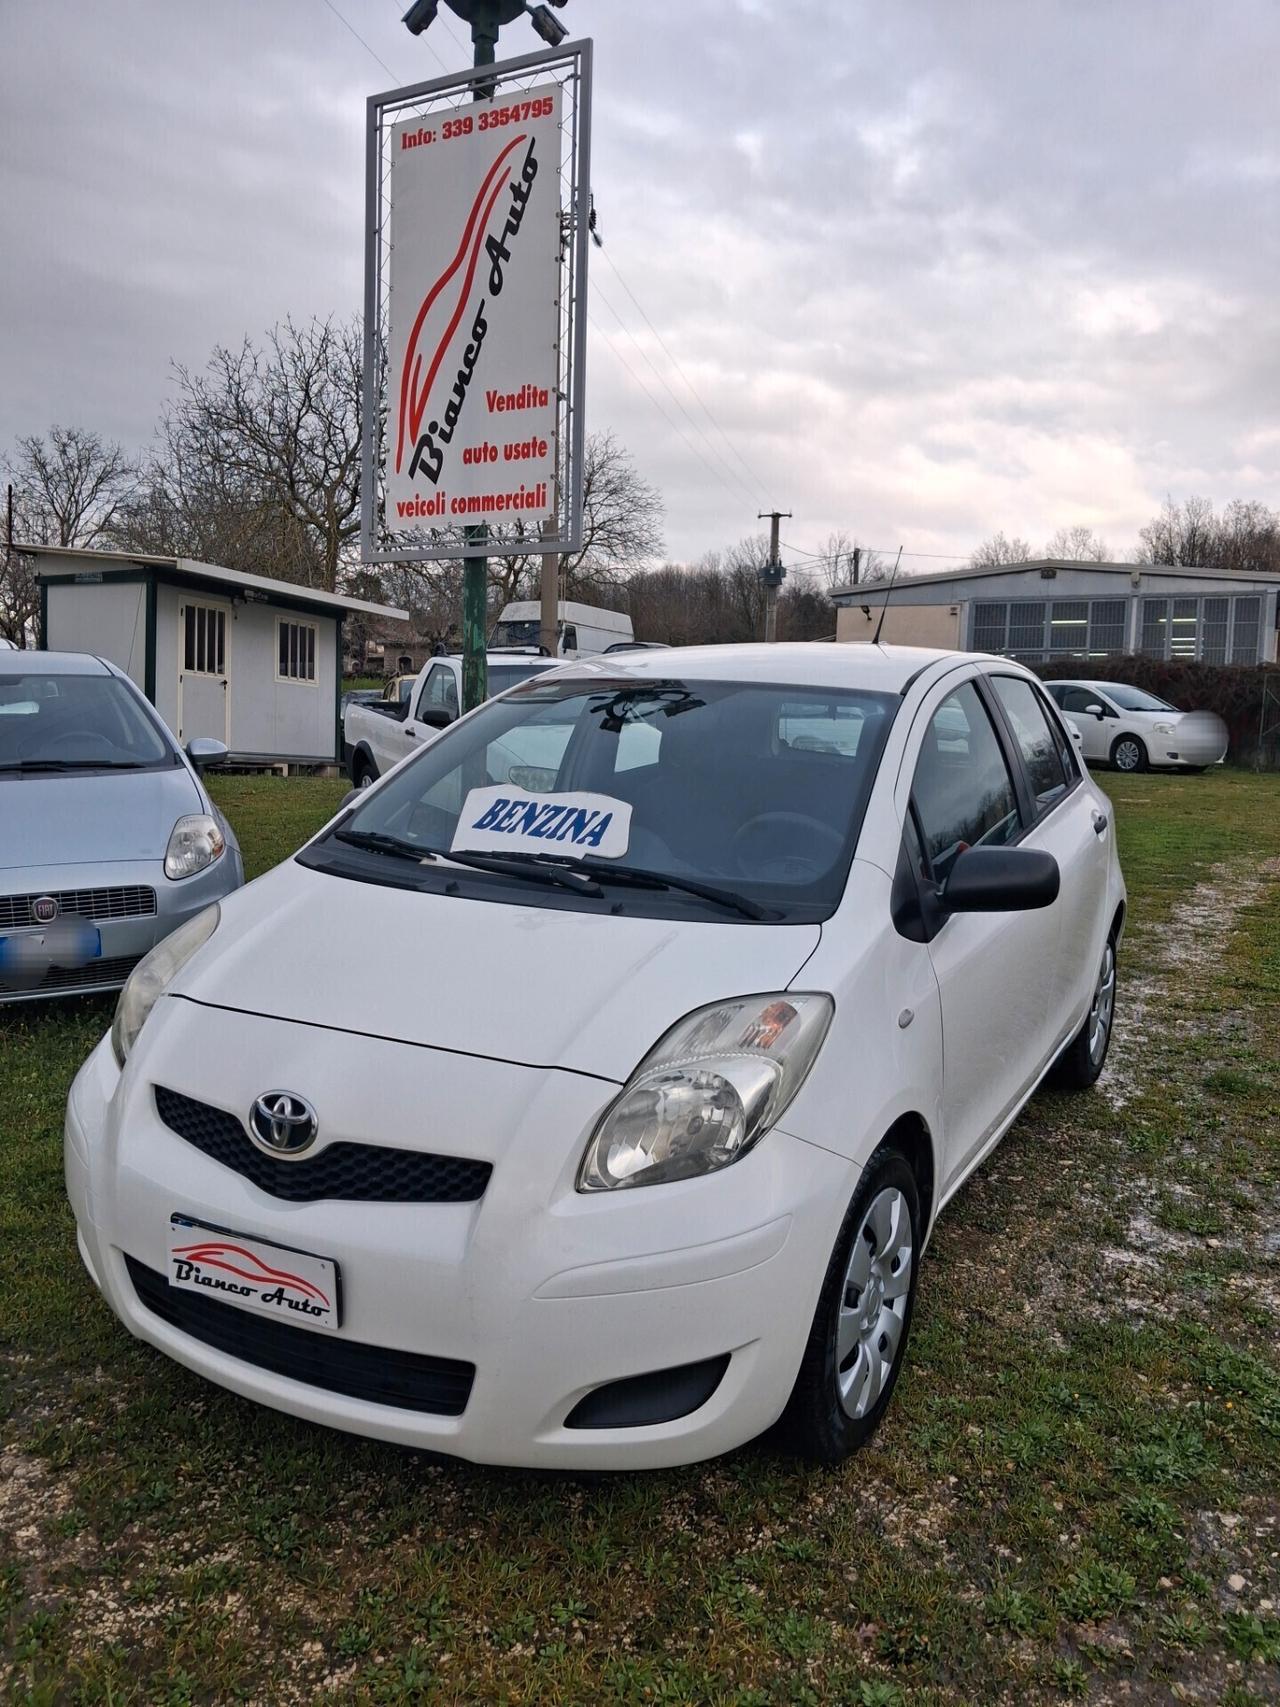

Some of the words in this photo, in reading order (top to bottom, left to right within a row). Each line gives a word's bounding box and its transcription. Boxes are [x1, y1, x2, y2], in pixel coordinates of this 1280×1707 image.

[401, 130, 437, 150] Info:
[442, 116, 474, 140] 339
[478, 96, 554, 131] 3354795
[408, 298, 488, 485] Bianco
[484, 136, 538, 296] Auto
[486, 384, 549, 412] Vendita
[463, 441, 498, 464] auto
[503, 436, 548, 461] usate
[396, 491, 446, 518] veicoli
[450, 483, 547, 514] commerciali
[471, 798, 614, 847] BENZINA
[38, 904, 53, 917] FIAT
[172, 1258, 258, 1297] Bianco
[260, 1287, 330, 1318] Auto
